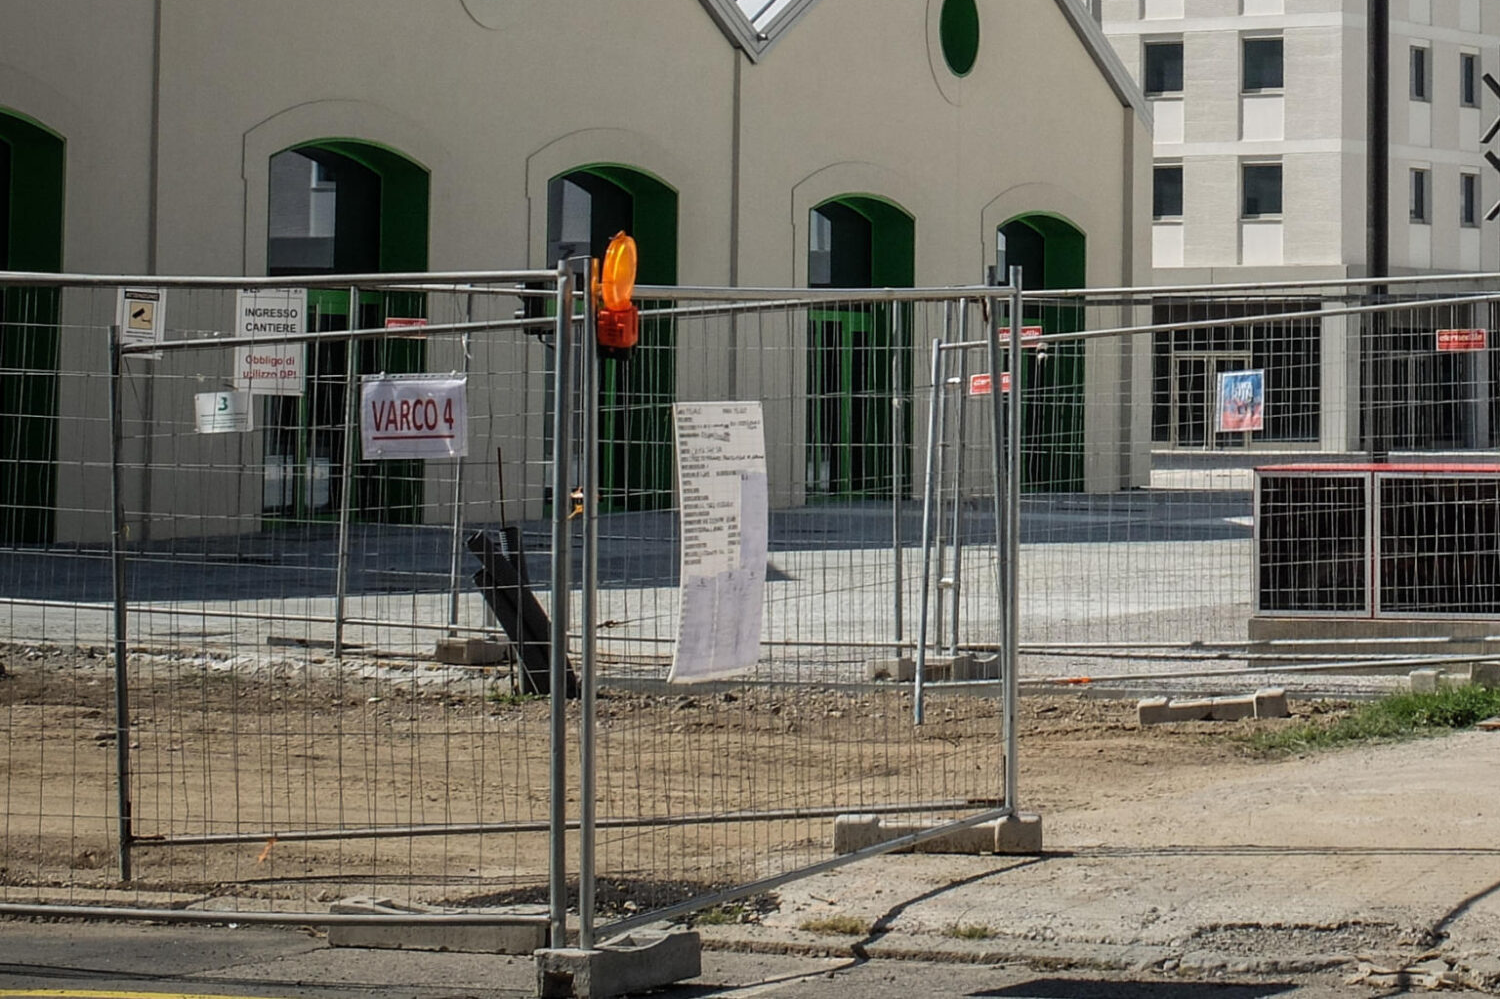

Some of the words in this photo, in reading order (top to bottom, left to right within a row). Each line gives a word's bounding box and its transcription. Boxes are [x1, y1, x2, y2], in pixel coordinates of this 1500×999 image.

[244, 307, 298, 319] INGRESSO
[245, 322, 297, 333] CANTIERE
[245, 354, 283, 367] Obbligo
[285, 356, 295, 366] di
[371, 398, 438, 432] VARCO
[443, 398, 454, 431] 4
